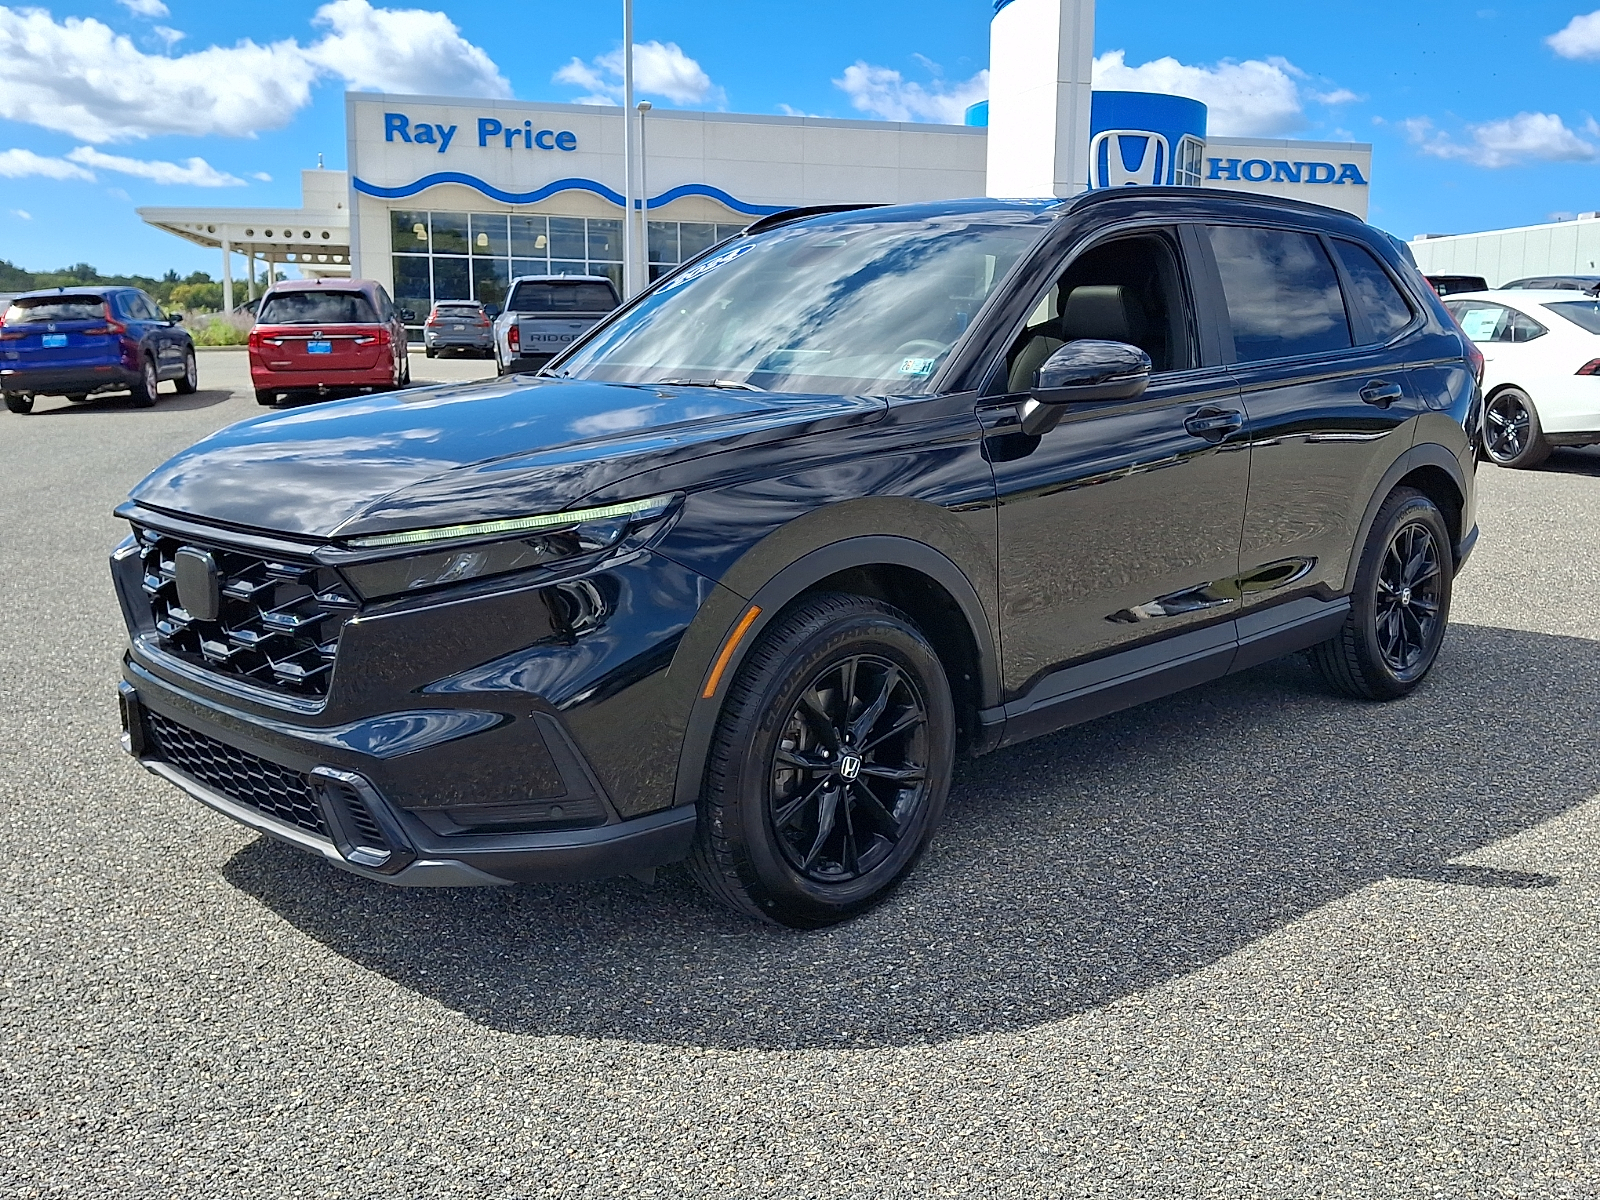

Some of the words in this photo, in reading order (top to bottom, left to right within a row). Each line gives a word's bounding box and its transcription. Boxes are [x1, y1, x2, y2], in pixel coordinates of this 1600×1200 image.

[384, 112, 457, 153] Ray
[477, 117, 577, 151] Price
[1206, 157, 1368, 185] HONDA
